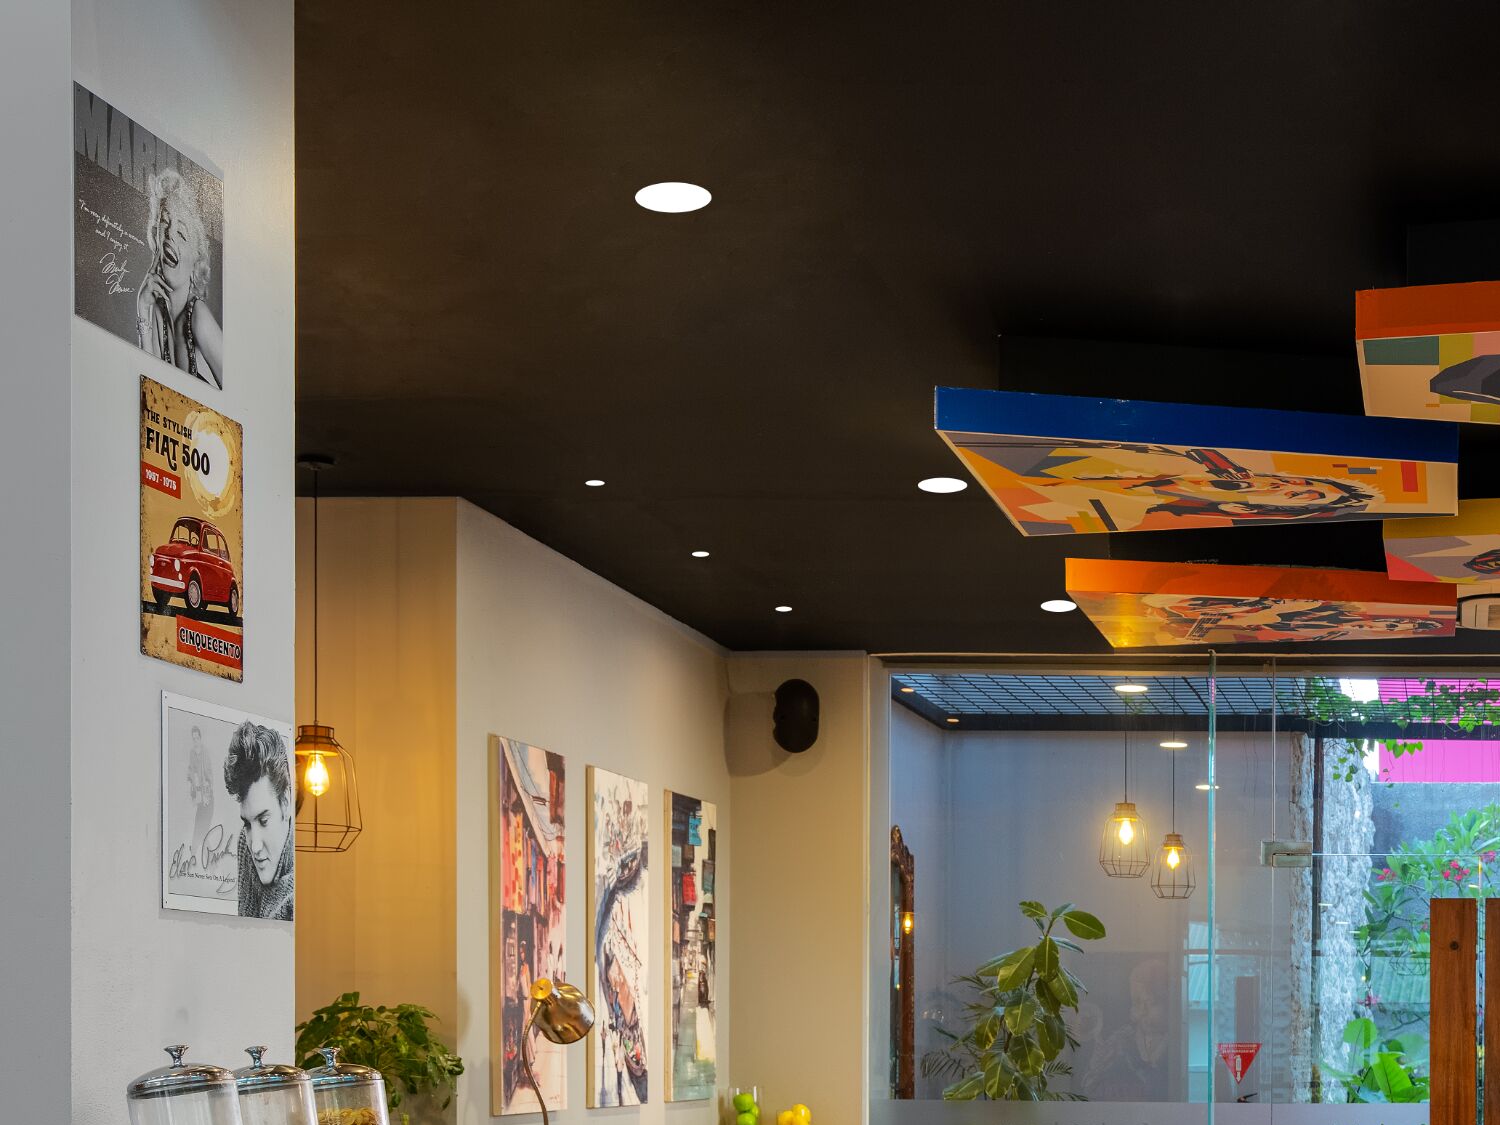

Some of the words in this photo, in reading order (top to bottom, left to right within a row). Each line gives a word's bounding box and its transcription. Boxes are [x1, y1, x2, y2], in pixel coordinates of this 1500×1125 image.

[144, 408, 160, 425] THE
[162, 416, 193, 440] STYLISH
[146, 426, 180, 472] FIAT
[182, 442, 211, 476] 500
[162, 476, 177, 491] 1975
[179, 626, 241, 660] CINQUECENTO
